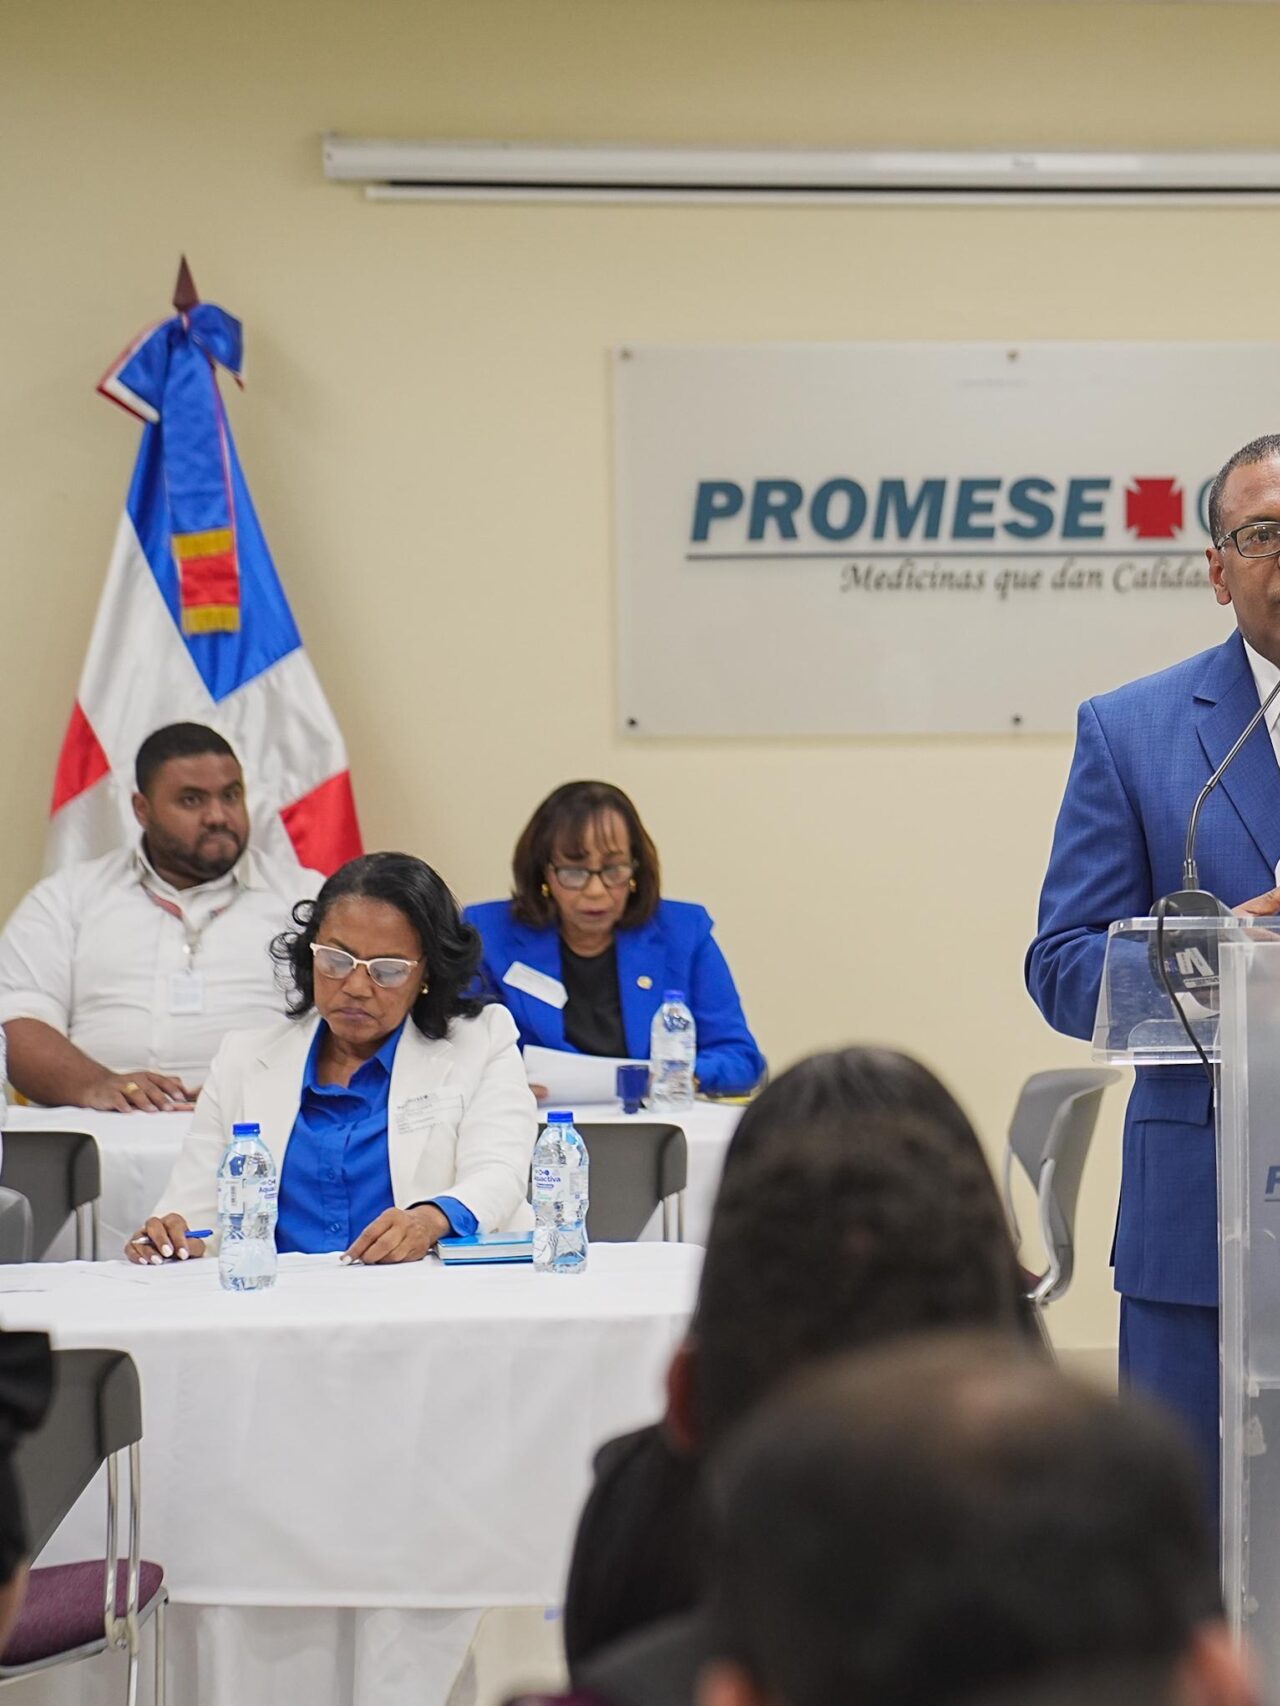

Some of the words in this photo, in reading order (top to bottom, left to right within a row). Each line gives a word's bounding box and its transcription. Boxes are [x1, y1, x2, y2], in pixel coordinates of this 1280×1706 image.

[690, 477, 1112, 542] PROMESE
[840, 557, 987, 592] Medicinas
[994, 566, 1043, 600] que
[1051, 556, 1104, 591] dan
[1112, 557, 1212, 594] Calida
